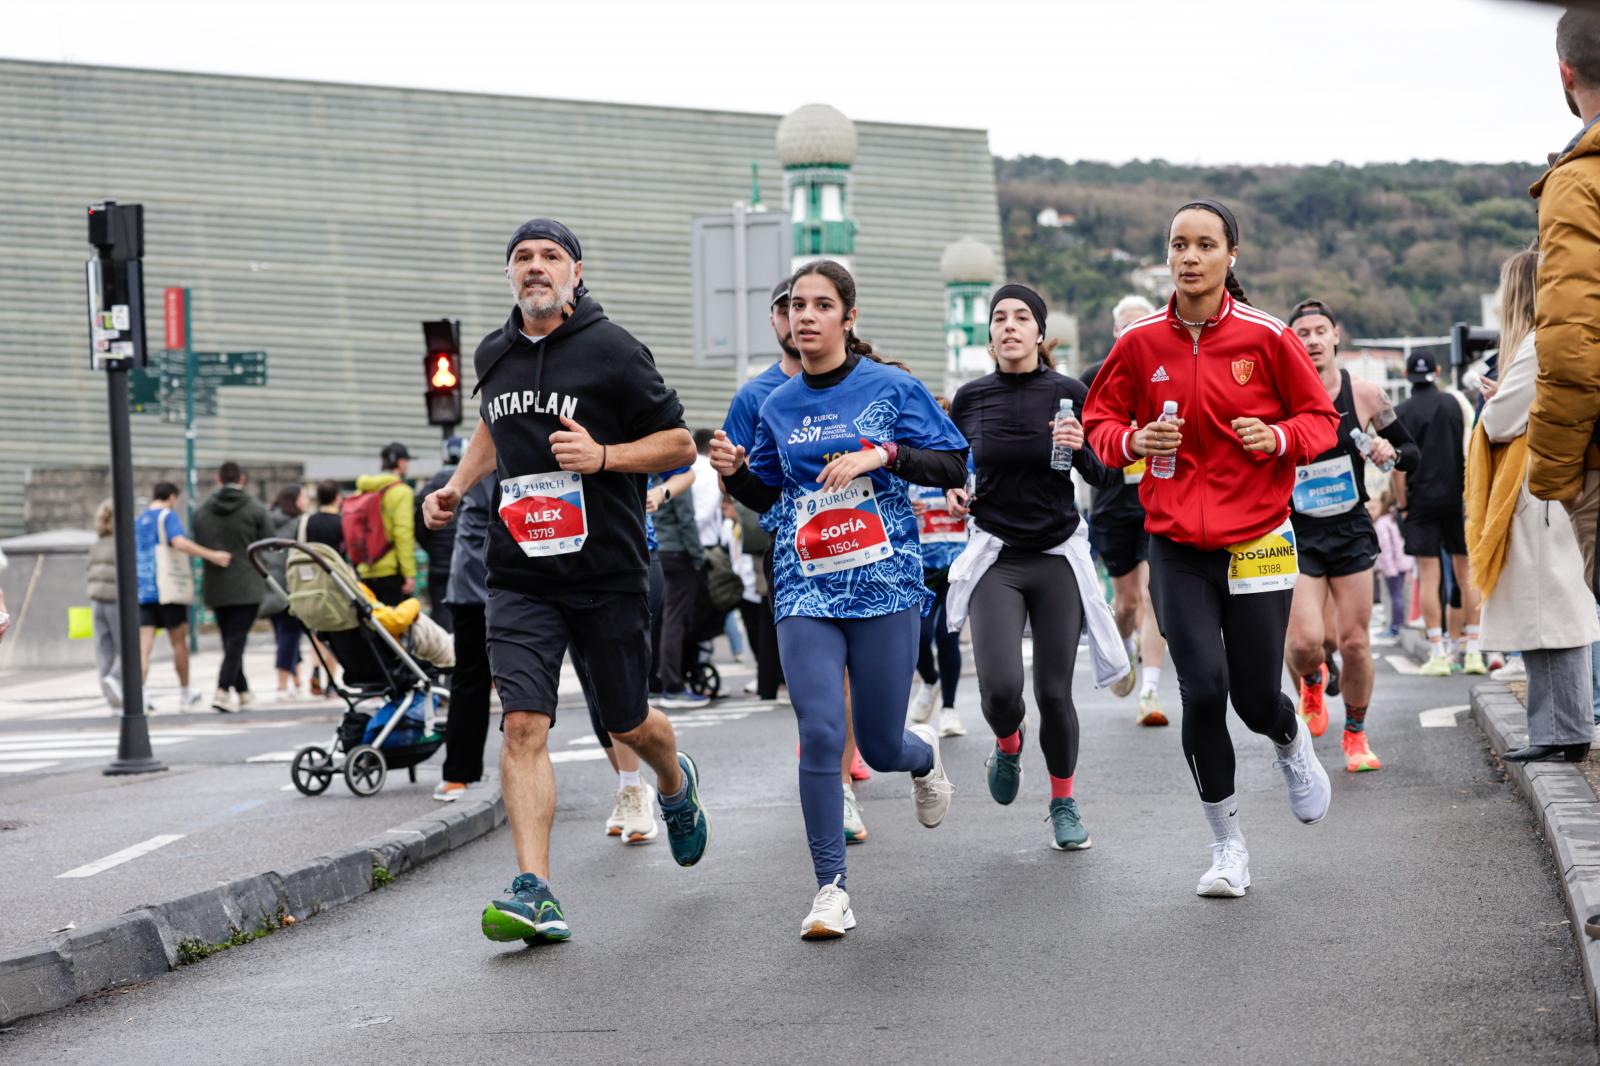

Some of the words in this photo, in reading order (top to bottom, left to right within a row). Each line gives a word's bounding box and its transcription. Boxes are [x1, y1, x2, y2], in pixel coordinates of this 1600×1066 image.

[488, 390, 578, 425] BATAPLAN
[813, 413, 838, 423] ZURICH
[523, 480, 565, 494] ZURICH
[1309, 482, 1346, 497] PIERRE
[819, 488, 859, 508] ZURICH
[525, 508, 563, 525] ALEX
[528, 527, 555, 540] 13719
[820, 517, 867, 541] SOFÍA
[827, 539, 859, 555] 11504
[1257, 563, 1282, 575] 13188
